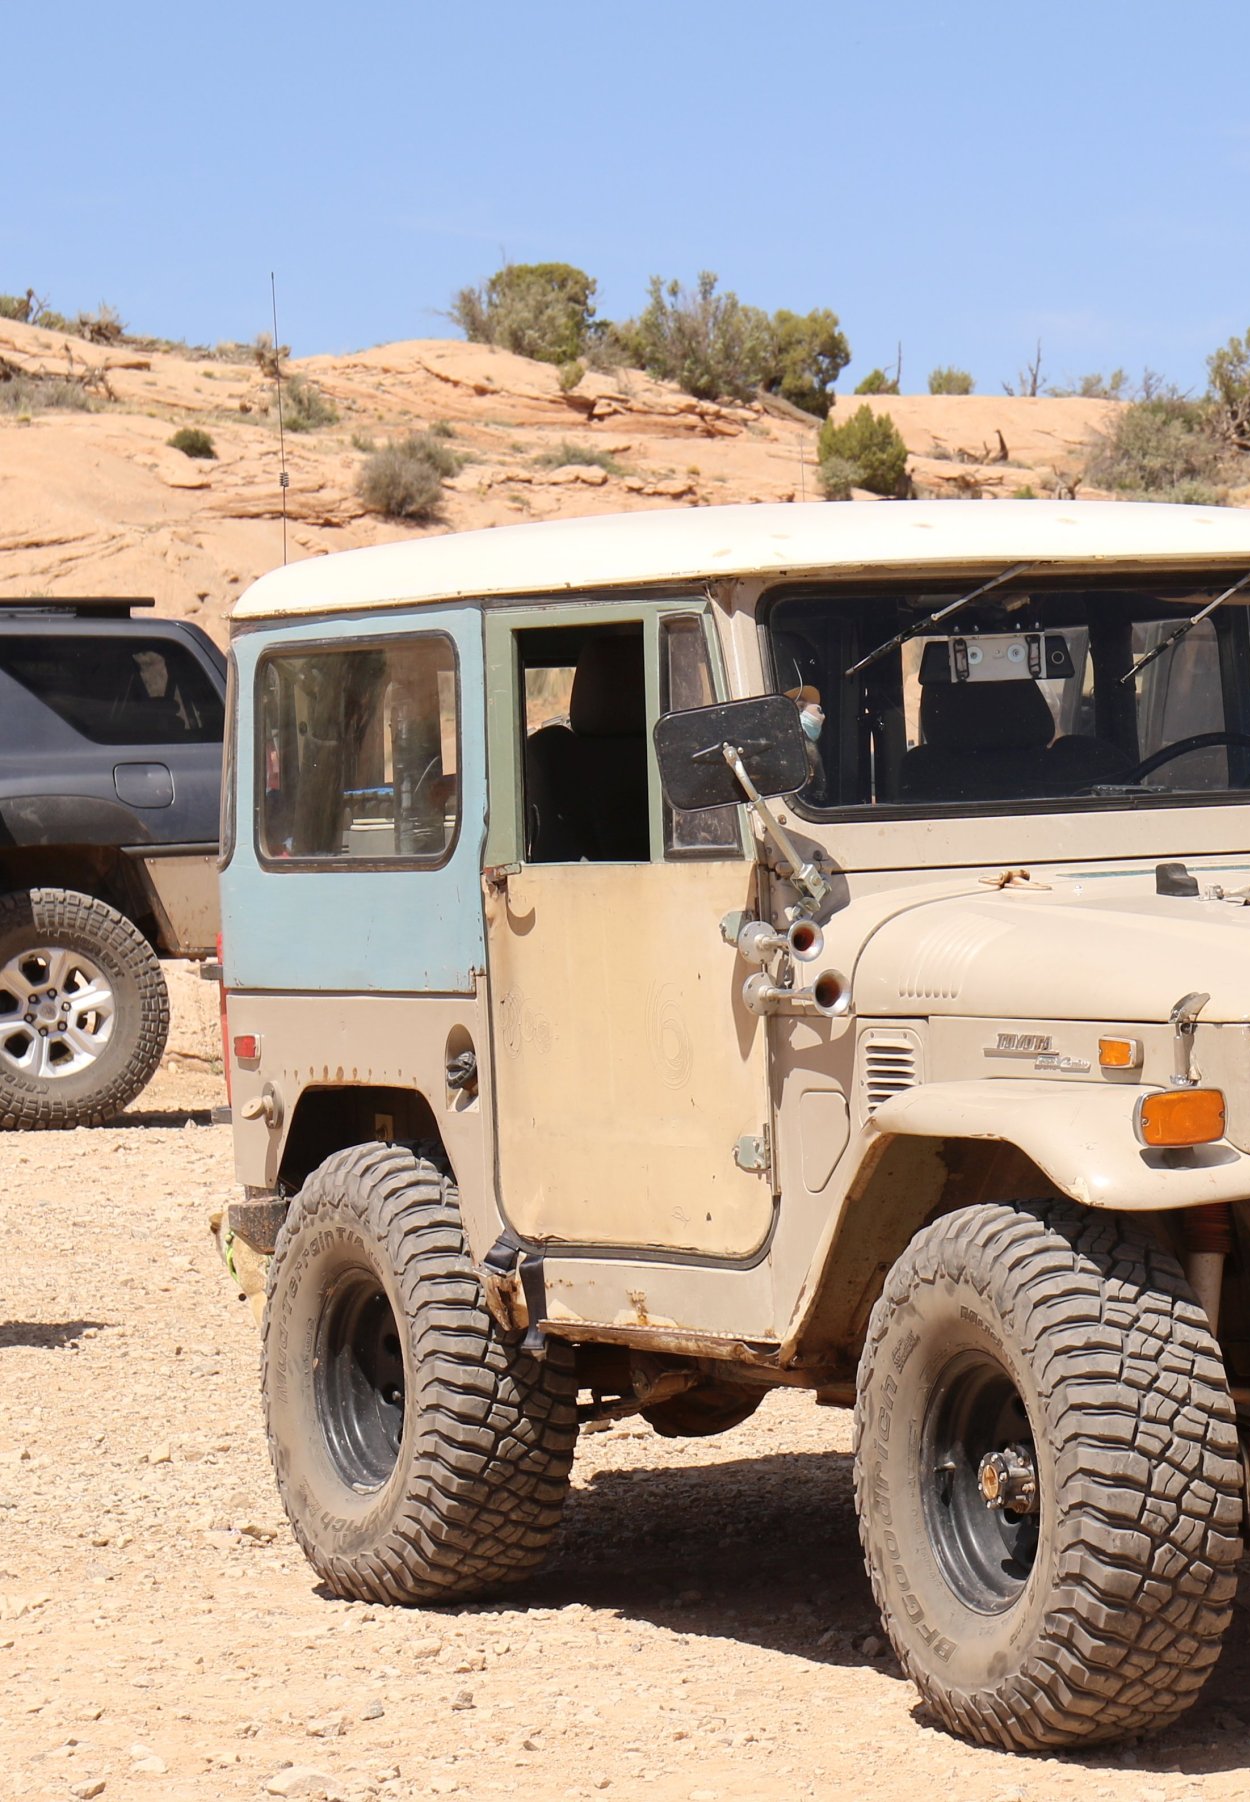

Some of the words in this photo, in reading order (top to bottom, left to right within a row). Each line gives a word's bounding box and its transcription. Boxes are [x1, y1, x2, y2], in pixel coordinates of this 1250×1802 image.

[997, 1033, 1053, 1050] TOYOTA
[276, 1229, 336, 1405] Mud-Terrain
[872, 1380, 960, 1665] BFGoodrich
